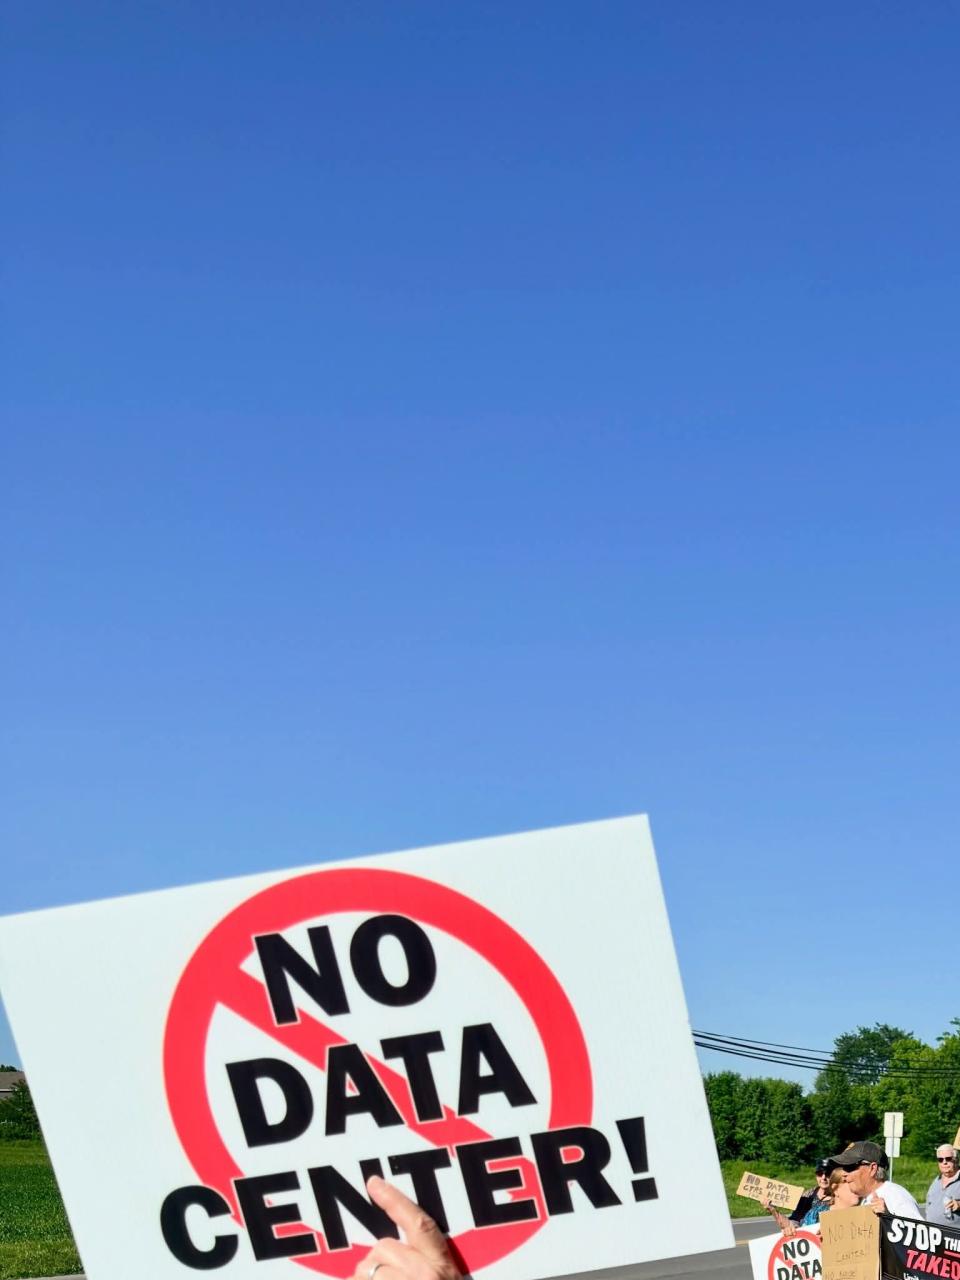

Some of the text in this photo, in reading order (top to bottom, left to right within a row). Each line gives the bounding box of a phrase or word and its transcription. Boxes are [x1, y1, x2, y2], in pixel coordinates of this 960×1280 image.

[254, 914, 437, 1026] NO
[225, 1022, 539, 1148] DATA
[160, 1116, 659, 1271] CENTER!
[746, 1174, 789, 1194] NO DATA
[782, 1238, 810, 1260] NO
[828, 1223, 844, 1244] NO
[887, 1218, 942, 1253] STOP
